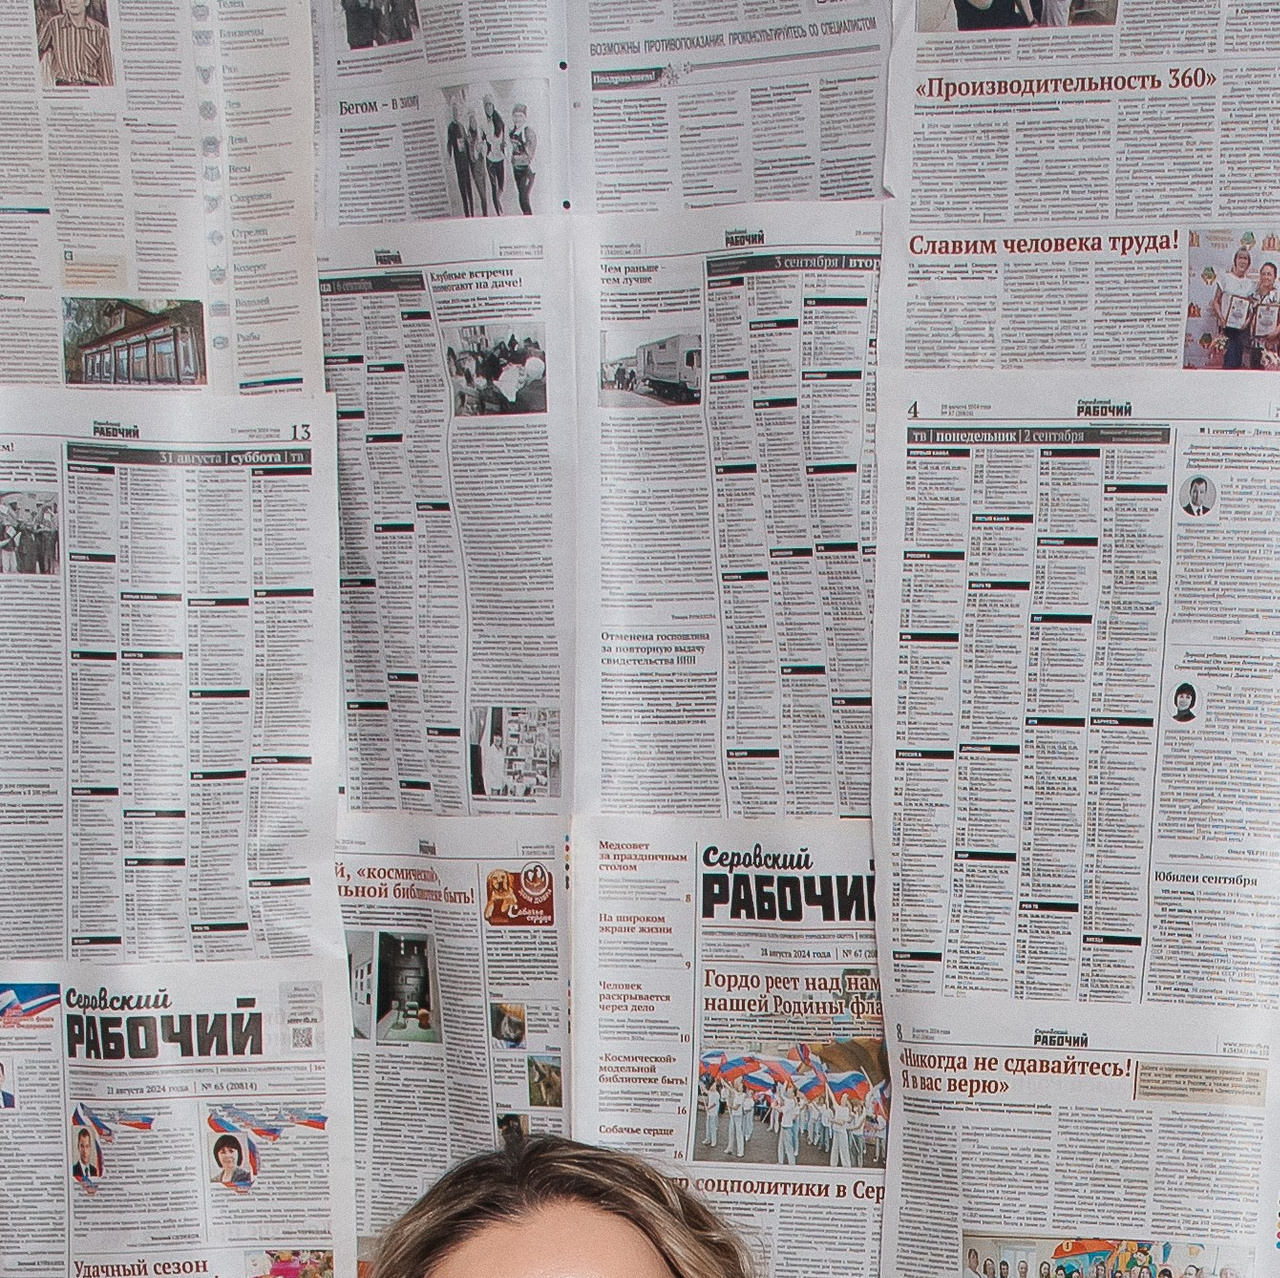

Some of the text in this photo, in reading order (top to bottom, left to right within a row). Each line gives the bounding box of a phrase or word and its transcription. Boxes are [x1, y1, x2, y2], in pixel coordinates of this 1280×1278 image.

[590, 38, 641, 56] ВОЗМОЖНЫ
[728, 28, 807, 48] ПРОКОНСУЛЬТИРУЙТЕСЬ
[809, 24, 819, 38] СО
[821, 18, 877, 36] СПЕЦИАЛИСТОМ
[916, 68, 1217, 101] «Производительность 360»
[339, 98, 377, 115] Бегом
[392, 98, 398, 110] в
[909, 229, 1179, 257] Славим человека труда!
[291, 424, 311, 441] 13
[913, 430, 1084, 445] тв понедельник 2 сентября
[160, 453, 304, 466] 31 августа суббота тв
[599, 981, 642, 991] Человек
[66, 987, 173, 1013] Серовский
[599, 993, 671, 1003] раскрывается
[599, 1003, 655, 1013] через дело
[67, 997, 263, 1060] РАБОЧИЙ
[900, 1047, 1131, 1078] «Никогда не сдавайтесь!
[902, 1070, 1009, 1098] Я в вас верю»
[695, 1177, 830, 1198] соцполитики
[74, 1259, 208, 1278] Удачный сезон
